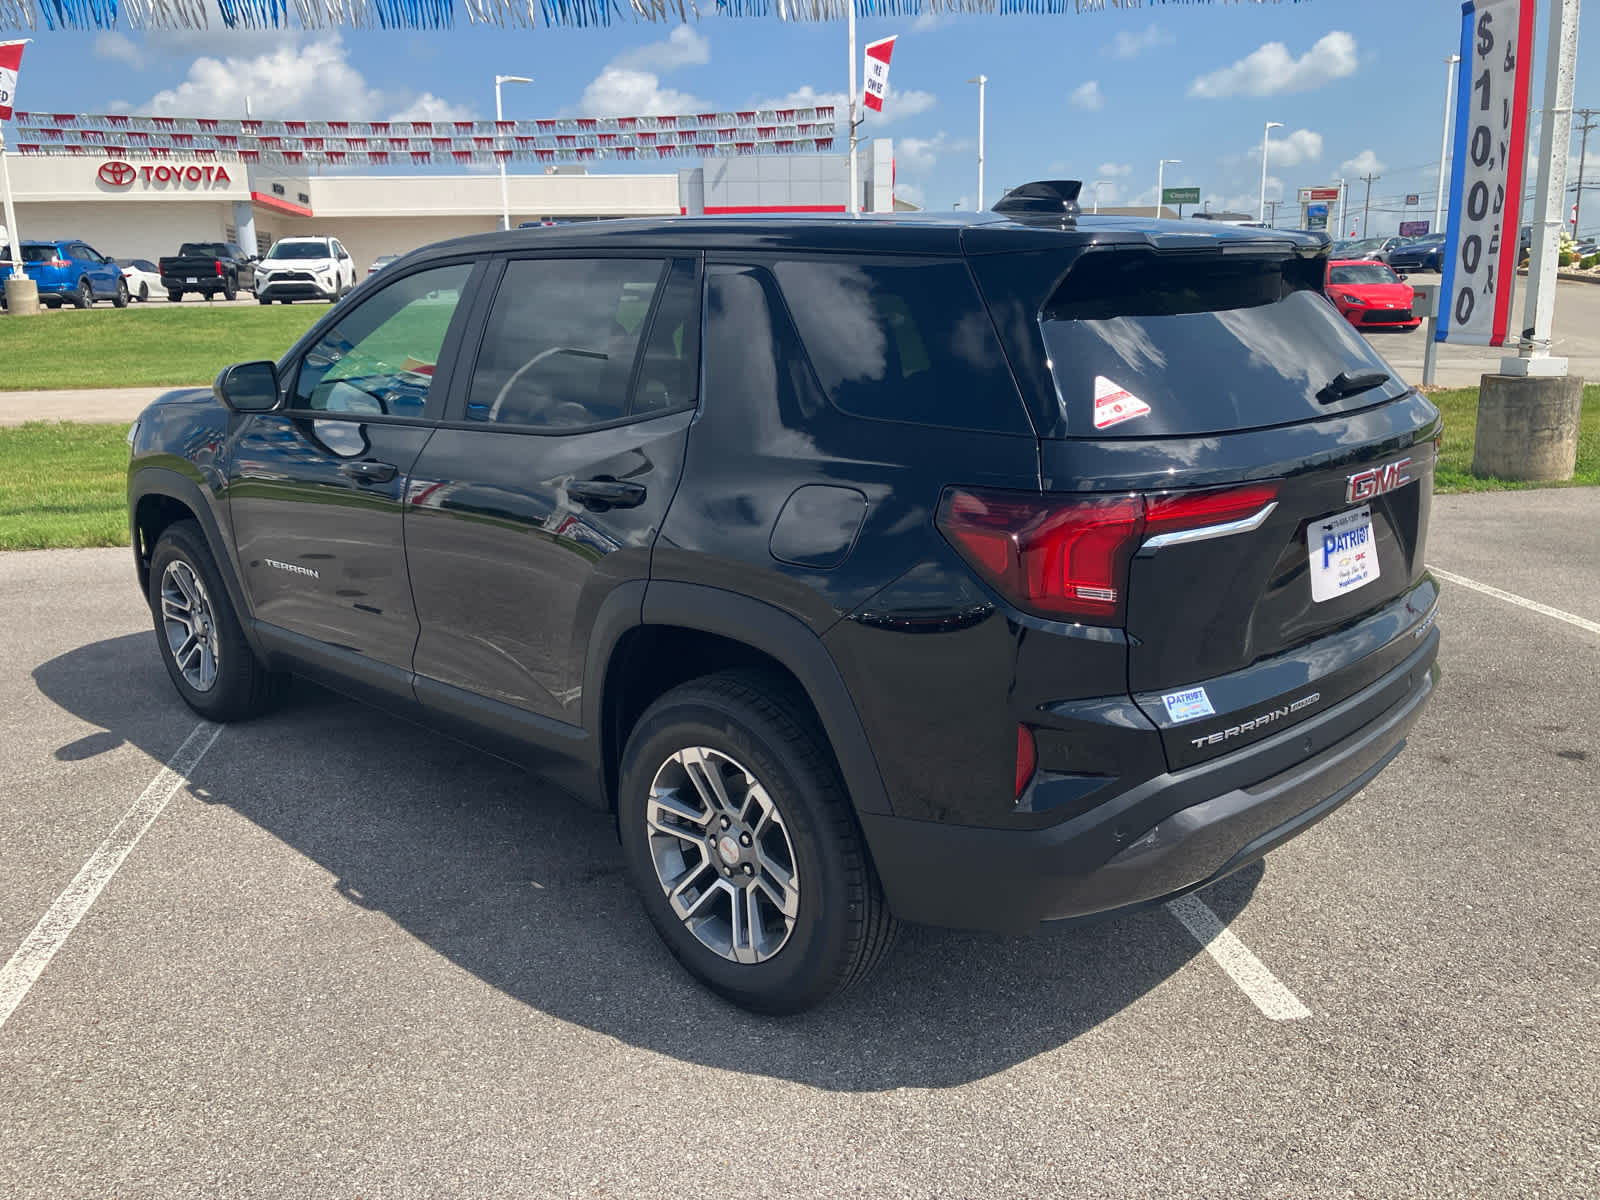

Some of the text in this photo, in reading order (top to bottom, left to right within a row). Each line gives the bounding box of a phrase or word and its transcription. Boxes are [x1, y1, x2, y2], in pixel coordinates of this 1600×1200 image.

[140, 166, 231, 183] TOYOTA
[1456, 10, 1495, 325] $10,000
[1347, 457, 1411, 503] GMC
[263, 558, 319, 579] TERRAIN
[1191, 706, 1289, 748] TERRAIN
